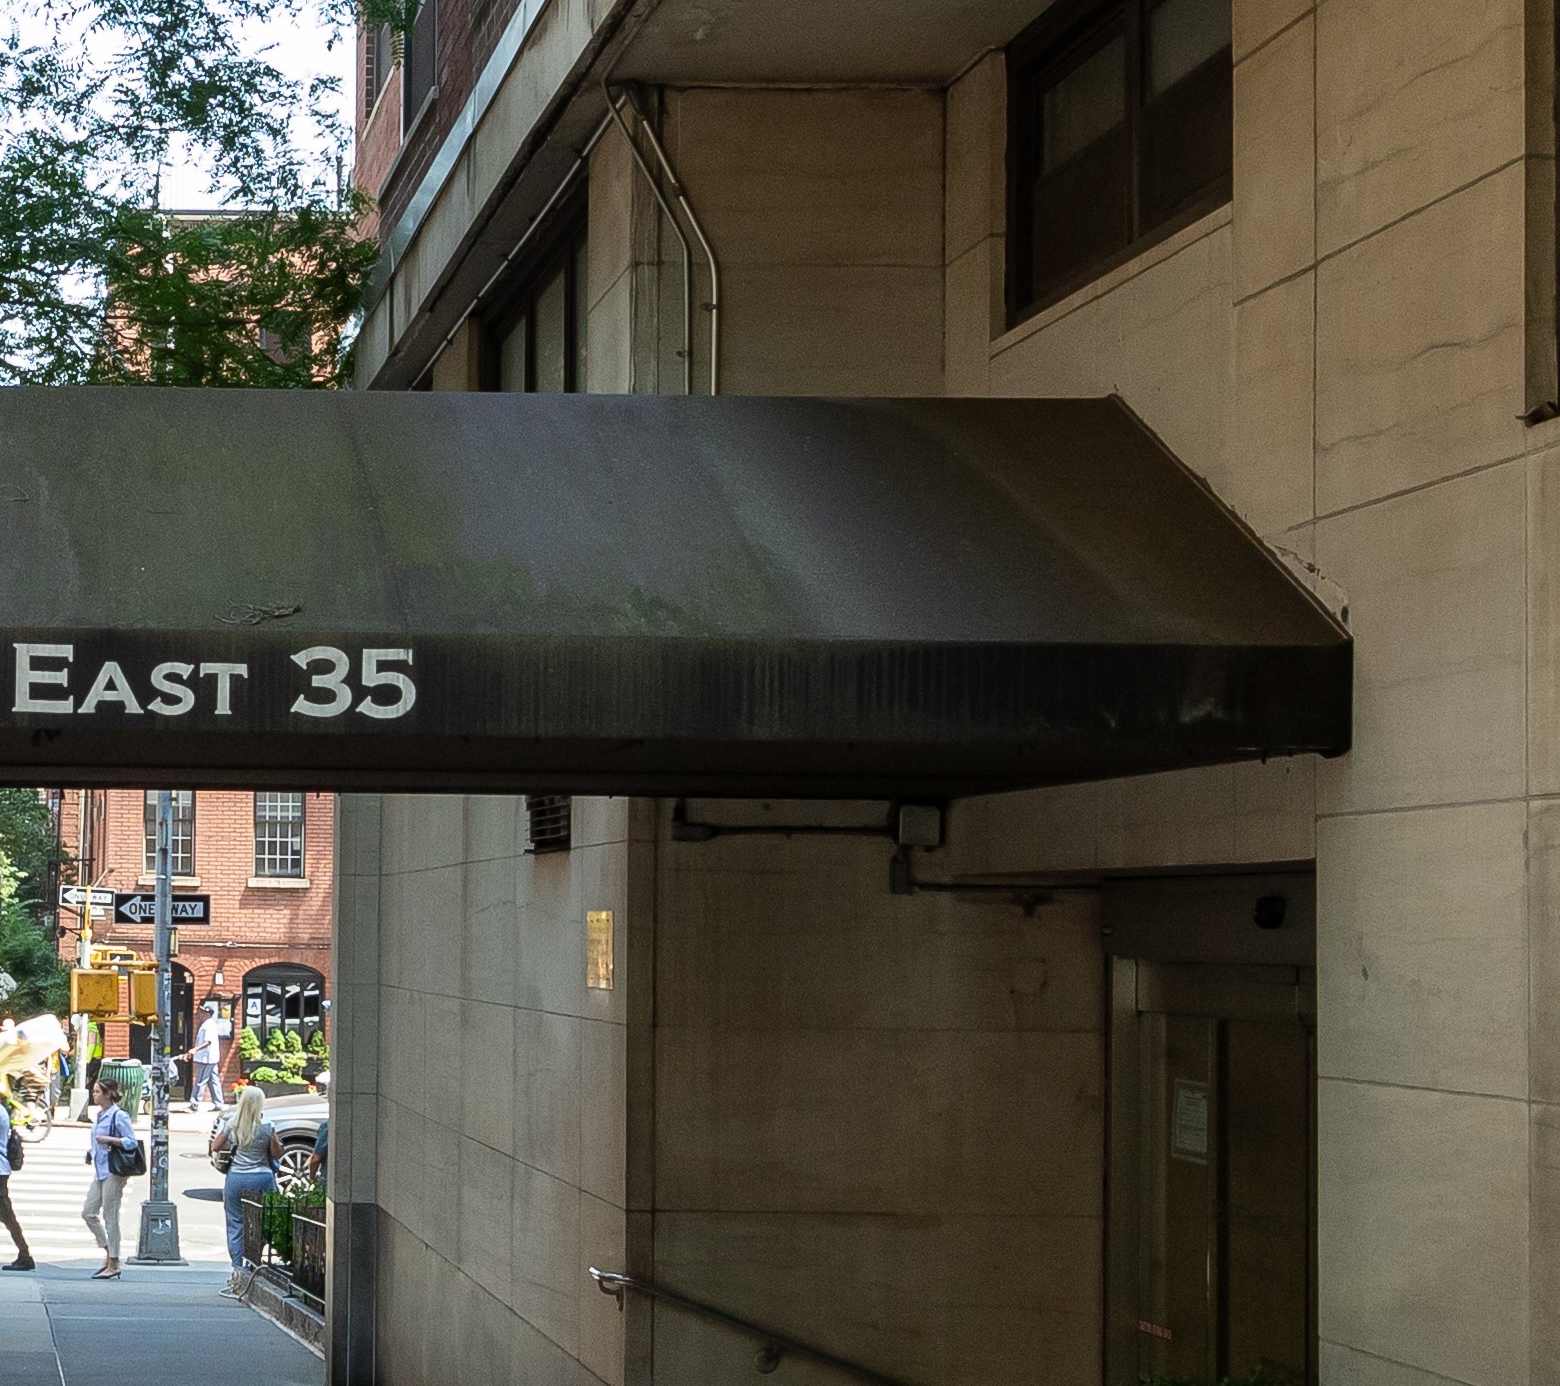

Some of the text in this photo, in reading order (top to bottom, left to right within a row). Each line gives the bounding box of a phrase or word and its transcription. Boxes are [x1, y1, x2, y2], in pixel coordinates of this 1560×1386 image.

[11, 642, 248, 716] EAST
[289, 646, 417, 719] 35
[129, 903, 198, 916] ONE WAY
